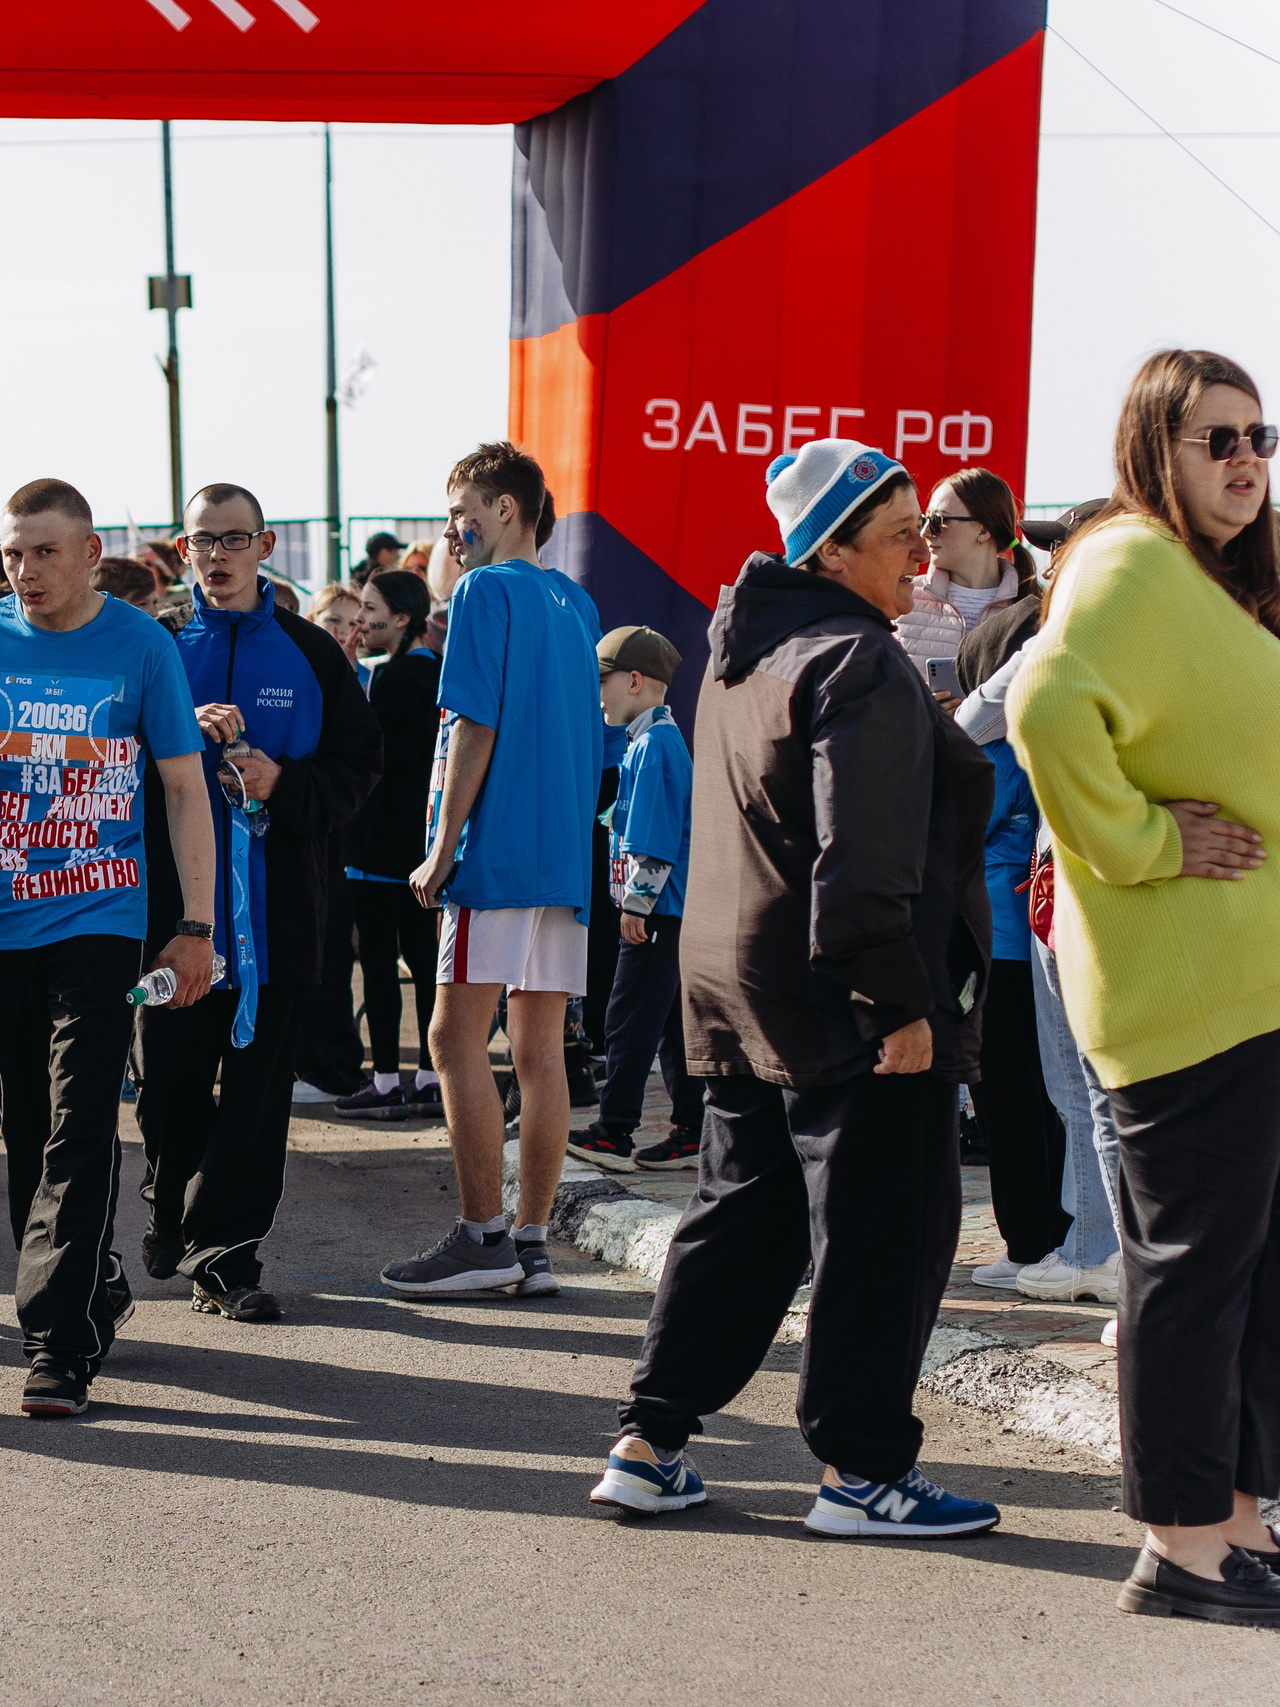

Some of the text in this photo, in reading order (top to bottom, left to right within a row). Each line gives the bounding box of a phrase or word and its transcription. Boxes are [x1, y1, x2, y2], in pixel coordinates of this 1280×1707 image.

[16, 677, 33, 685] ПСБ
[259, 688, 293, 697] АРМИЯ
[256, 698, 293, 708] РОССИИ
[17, 701, 88, 732] 20036
[12, 858, 139, 900] #ЕДИНСТВО
